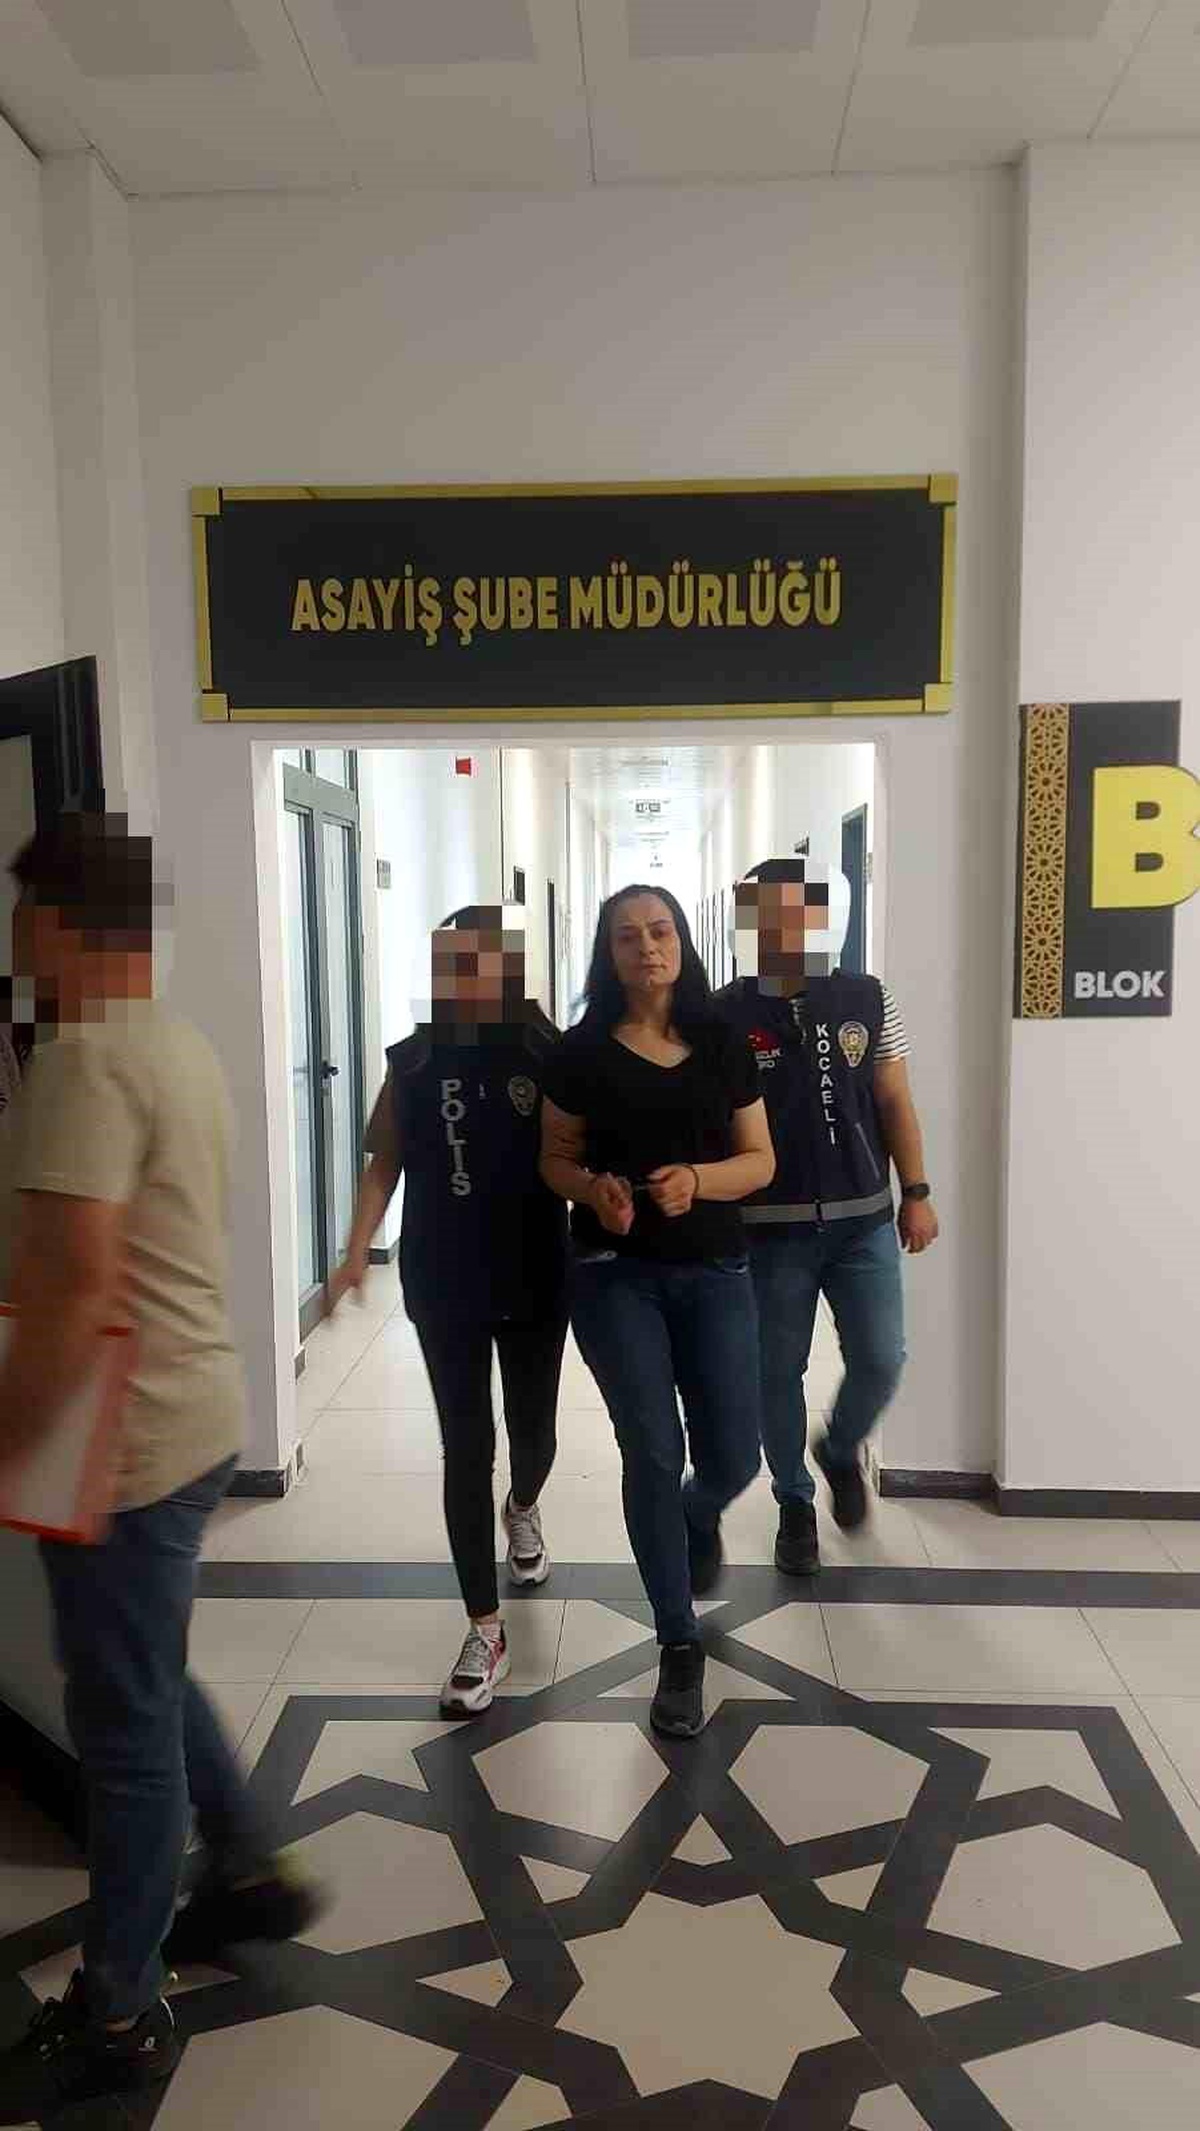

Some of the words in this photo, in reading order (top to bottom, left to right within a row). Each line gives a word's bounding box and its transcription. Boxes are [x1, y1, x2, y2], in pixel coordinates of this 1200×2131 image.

[292, 564, 442, 645] ASAYİŞ
[454, 575, 559, 645] ŞUBE
[570, 557, 842, 630] MÜDÜRLÜĞÜ
[1092, 765, 1200, 909] B
[1074, 971, 1166, 999] BLOK
